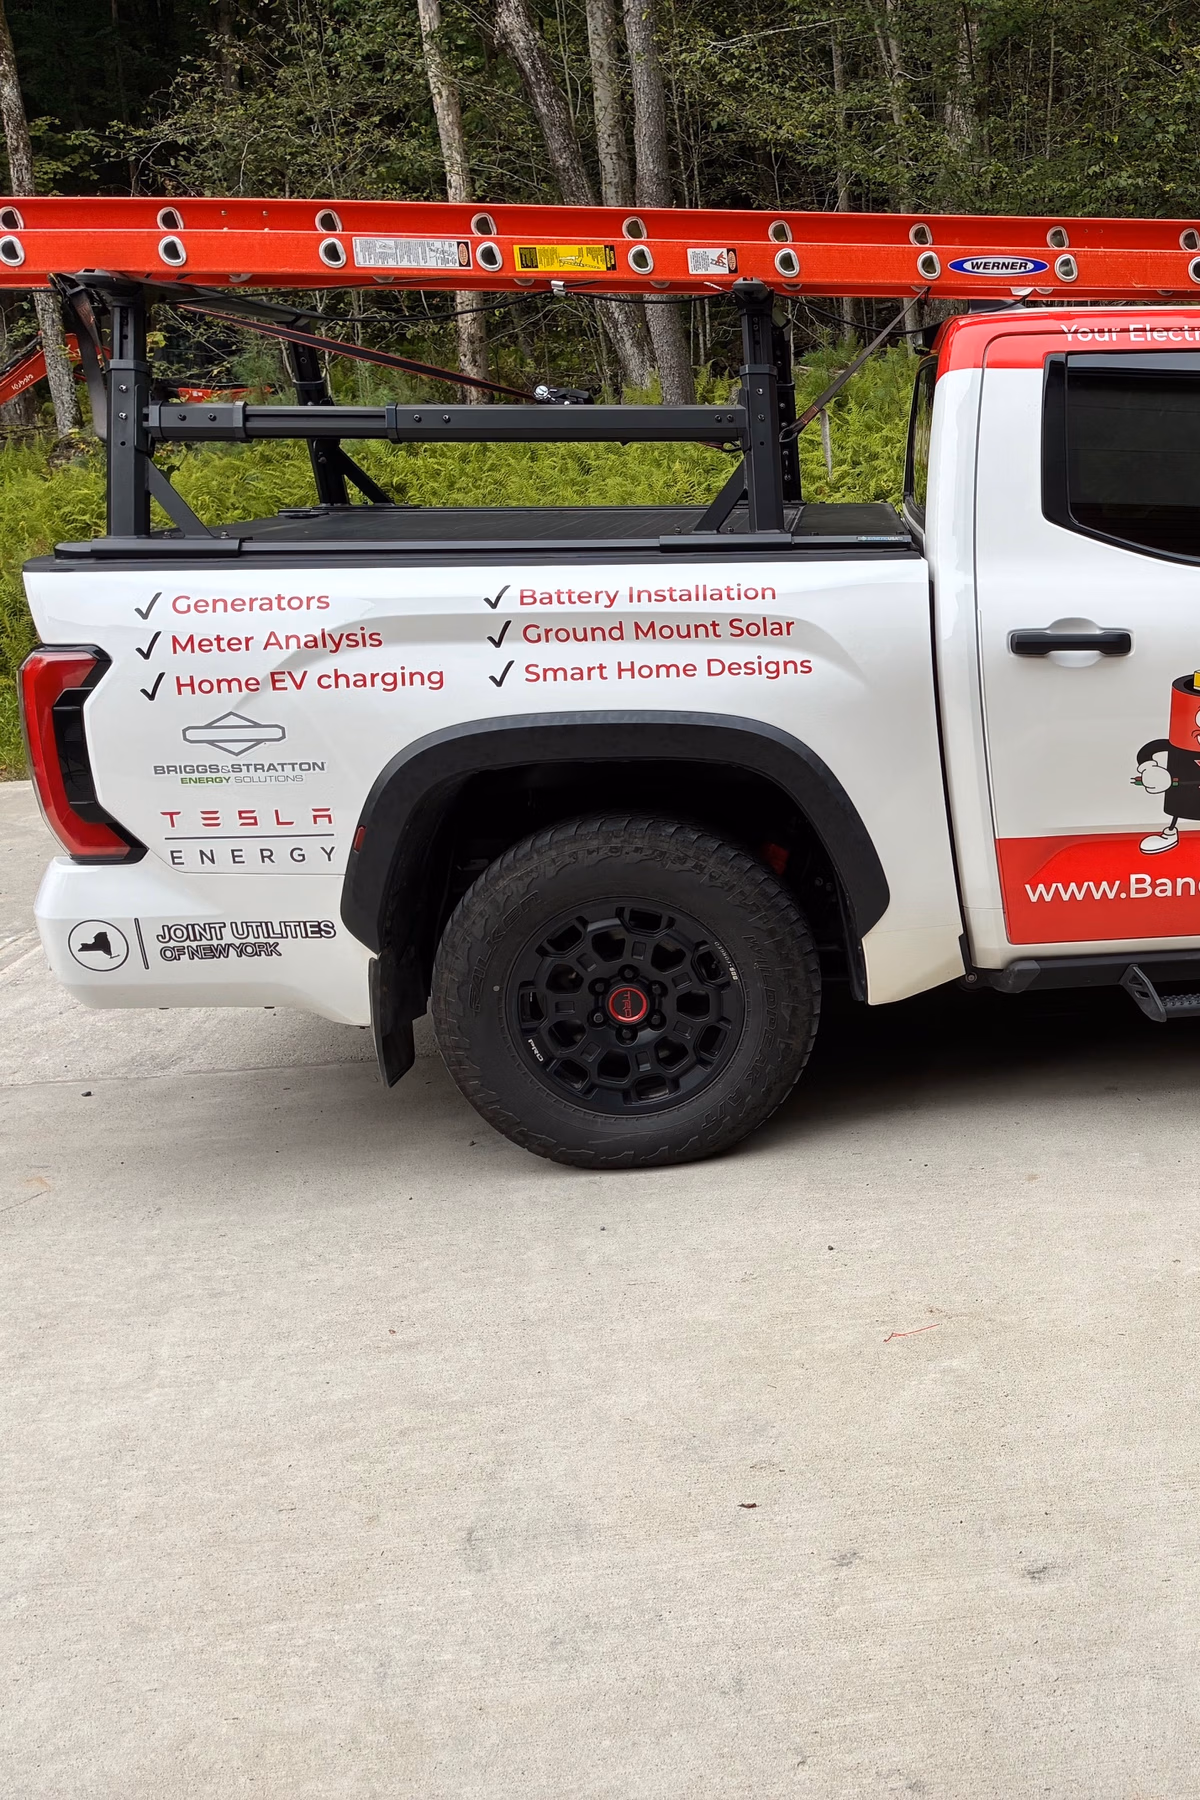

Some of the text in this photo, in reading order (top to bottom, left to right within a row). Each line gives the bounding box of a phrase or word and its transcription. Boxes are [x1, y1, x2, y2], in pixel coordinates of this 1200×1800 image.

[970, 262, 1028, 271] WERNER
[1060, 324, 1120, 342] Your
[172, 593, 330, 615] Generators
[519, 583, 777, 610] Battery Installation
[171, 626, 384, 655] Meter Analysis
[522, 616, 795, 645] Ground Mount Solar
[524, 655, 813, 683] Smart Home Designs
[175, 665, 445, 696] Home EV charging
[153, 761, 325, 775] BRIGGS&STRATTON
[180, 775, 304, 785] ENERGY SOLUTIONS
[160, 807, 333, 828] TESLA
[170, 845, 335, 866] ENERGY
[156, 919, 336, 944] JOINT UTILITIES
[159, 945, 186, 962] OF
